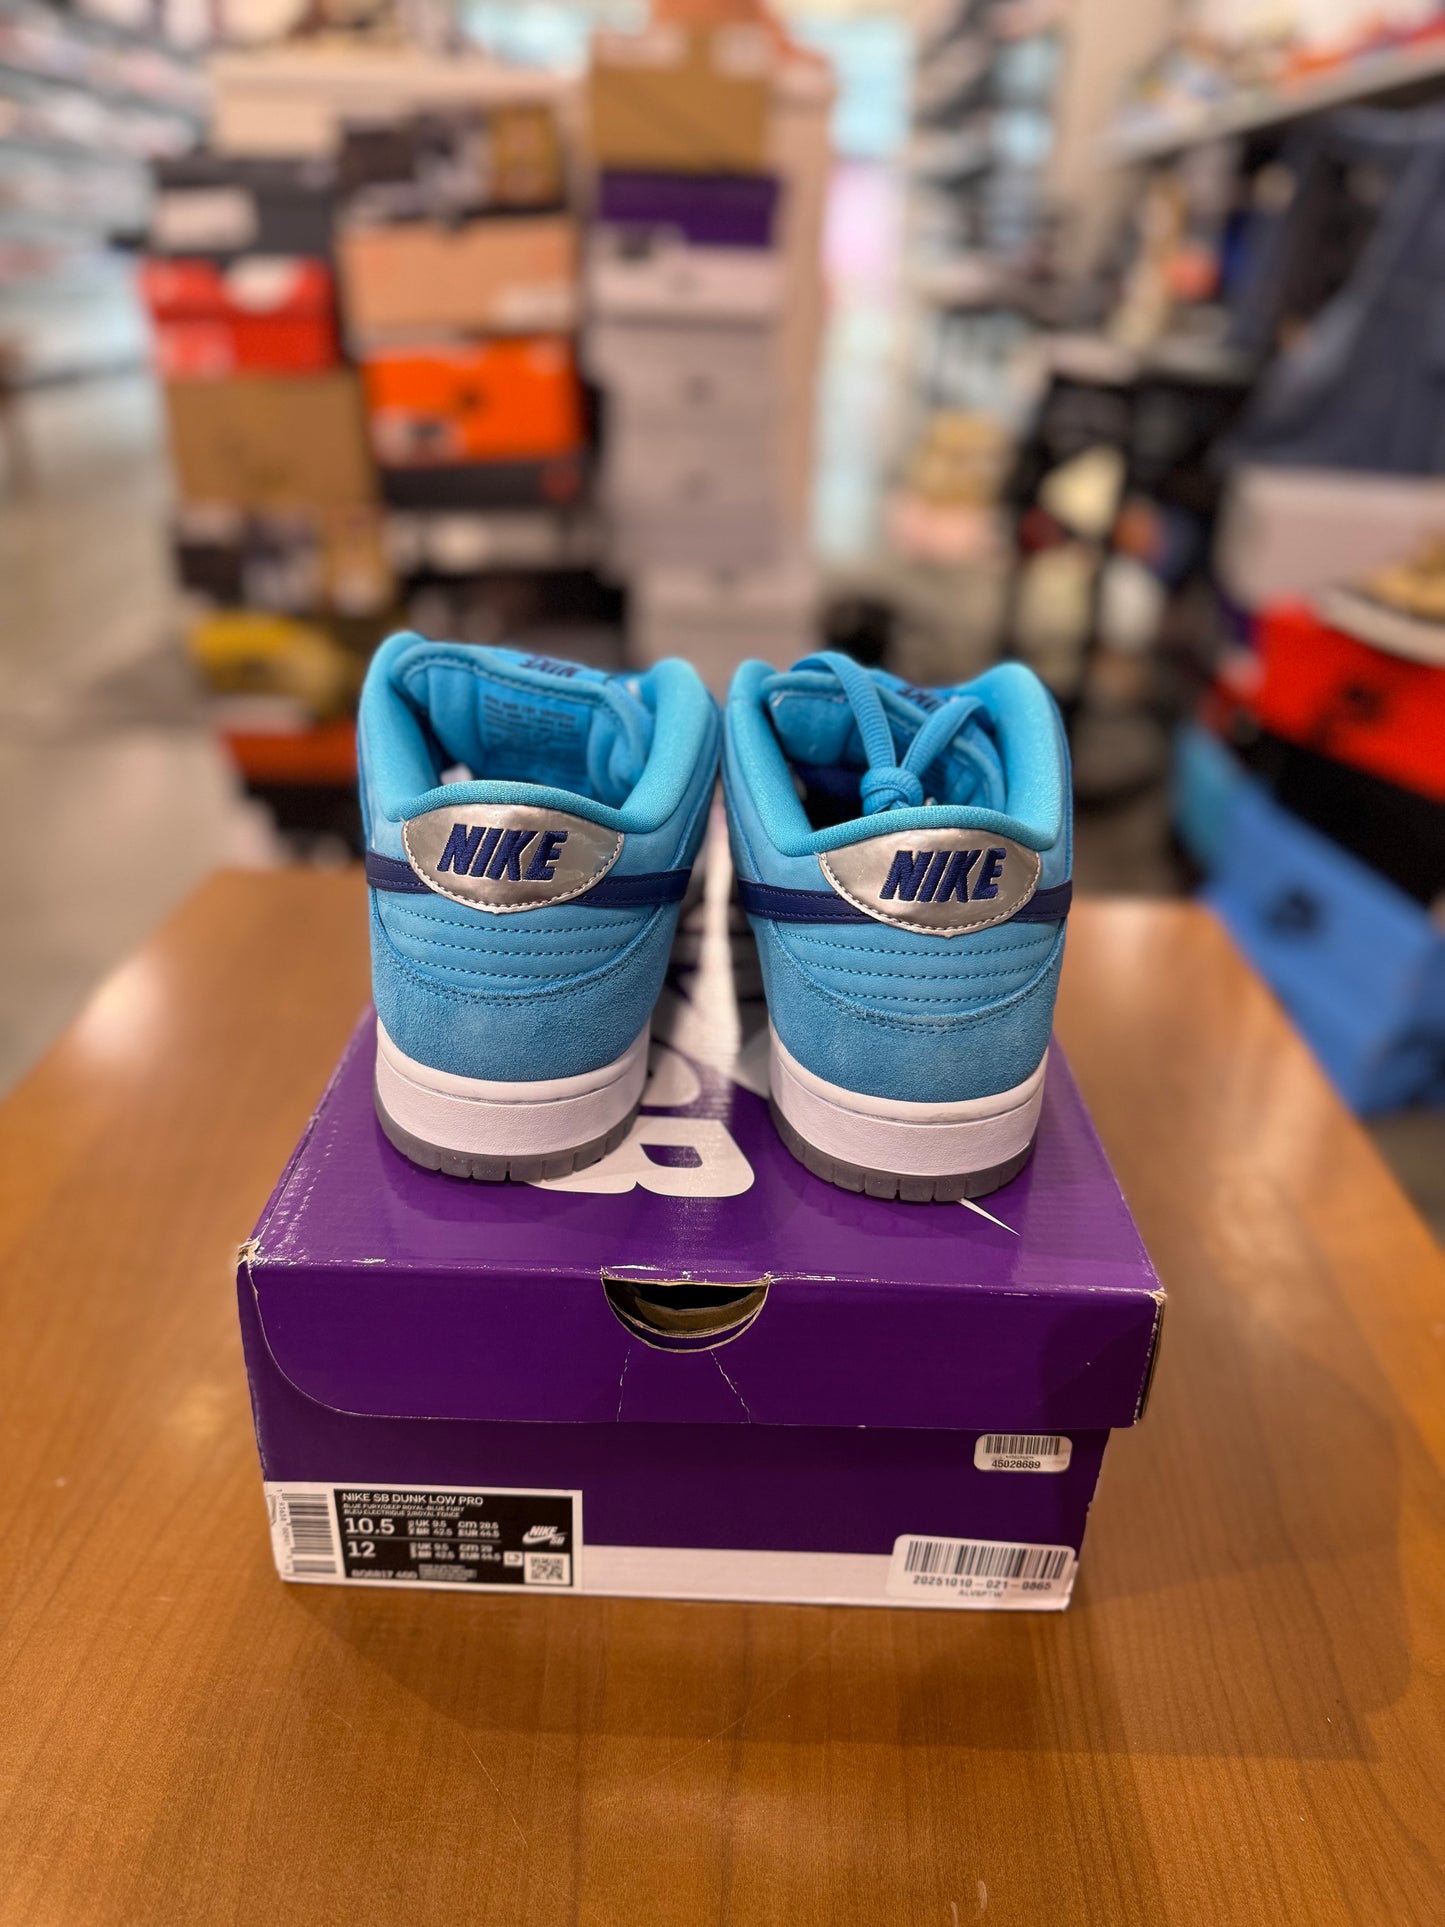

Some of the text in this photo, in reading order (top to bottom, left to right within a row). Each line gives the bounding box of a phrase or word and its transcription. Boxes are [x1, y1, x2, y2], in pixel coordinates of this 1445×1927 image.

[436, 823, 569, 882] NIKE
[879, 848, 1007, 903] NIKE
[991, 1460, 1041, 1469] 45028689
[342, 1492, 484, 1506] NIKE SB DUNK LOW PRO
[344, 1517, 395, 1535] 10.5
[457, 1521, 477, 1529] cm
[529, 1525, 559, 1537] NIKE
[457, 1529, 478, 1537] EUR
[347, 1541, 376, 1558] 12
[459, 1544, 479, 1552] cm
